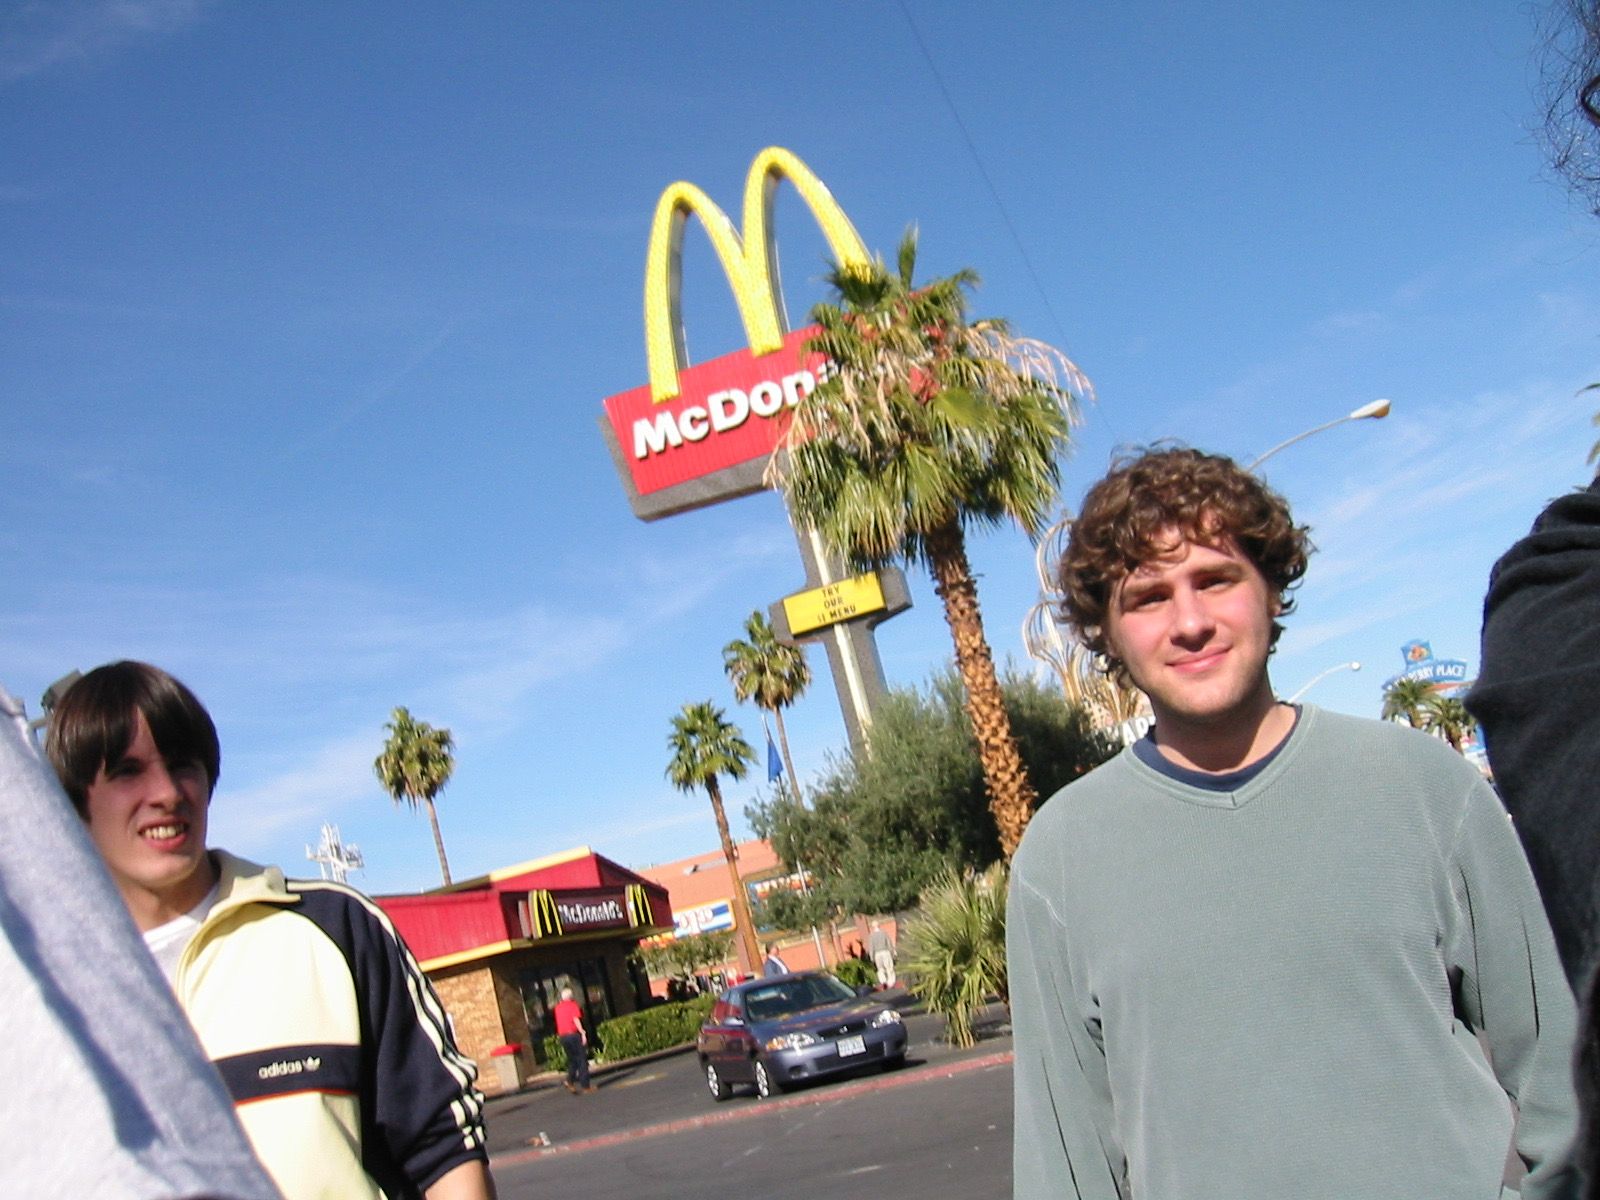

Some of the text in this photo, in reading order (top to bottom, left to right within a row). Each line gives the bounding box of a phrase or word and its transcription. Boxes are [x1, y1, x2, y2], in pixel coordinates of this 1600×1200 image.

[822, 584, 839, 598] TRY
[829, 605, 856, 618] MENU
[1437, 664, 1465, 677] PLACE
[557, 901, 623, 924] McDonald's
[258, 1060, 303, 1079] adidas
